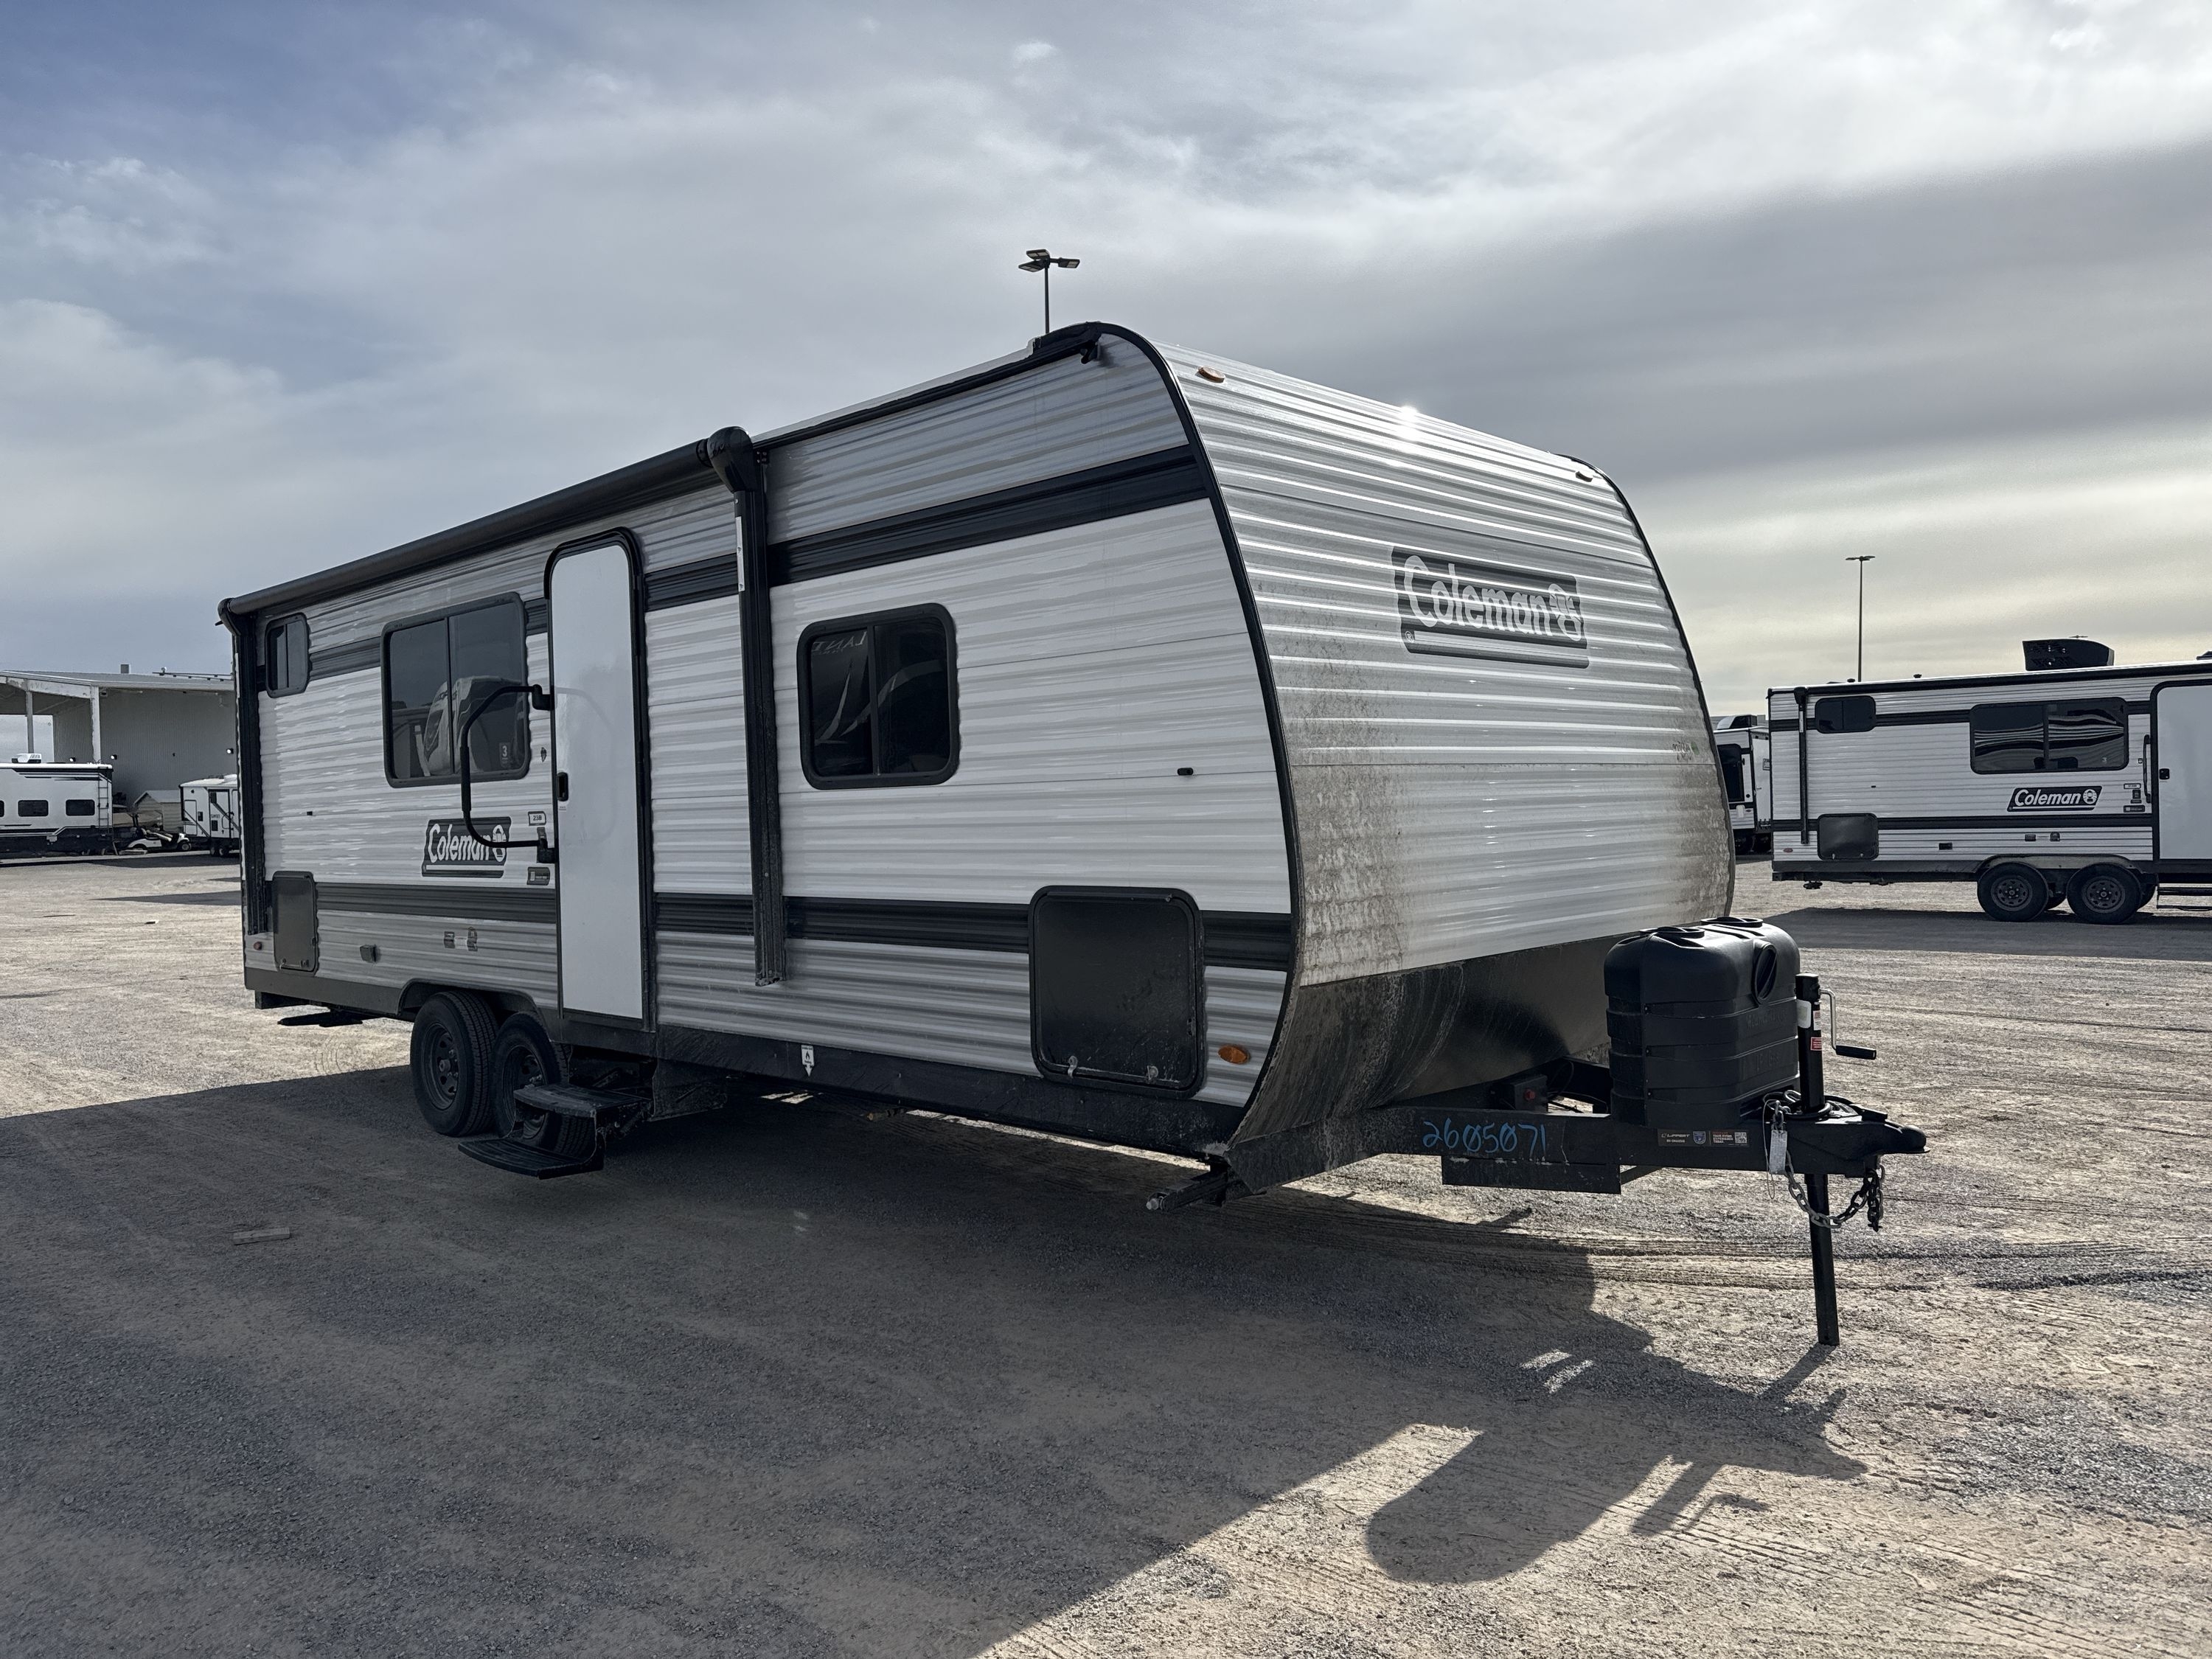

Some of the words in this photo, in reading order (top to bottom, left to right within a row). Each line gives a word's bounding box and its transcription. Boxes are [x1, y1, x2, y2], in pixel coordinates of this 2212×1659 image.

[1404, 555, 1554, 637] Coleman
[2014, 789, 2081, 807] Coleman
[1422, 1117, 1546, 1157] 2605071
